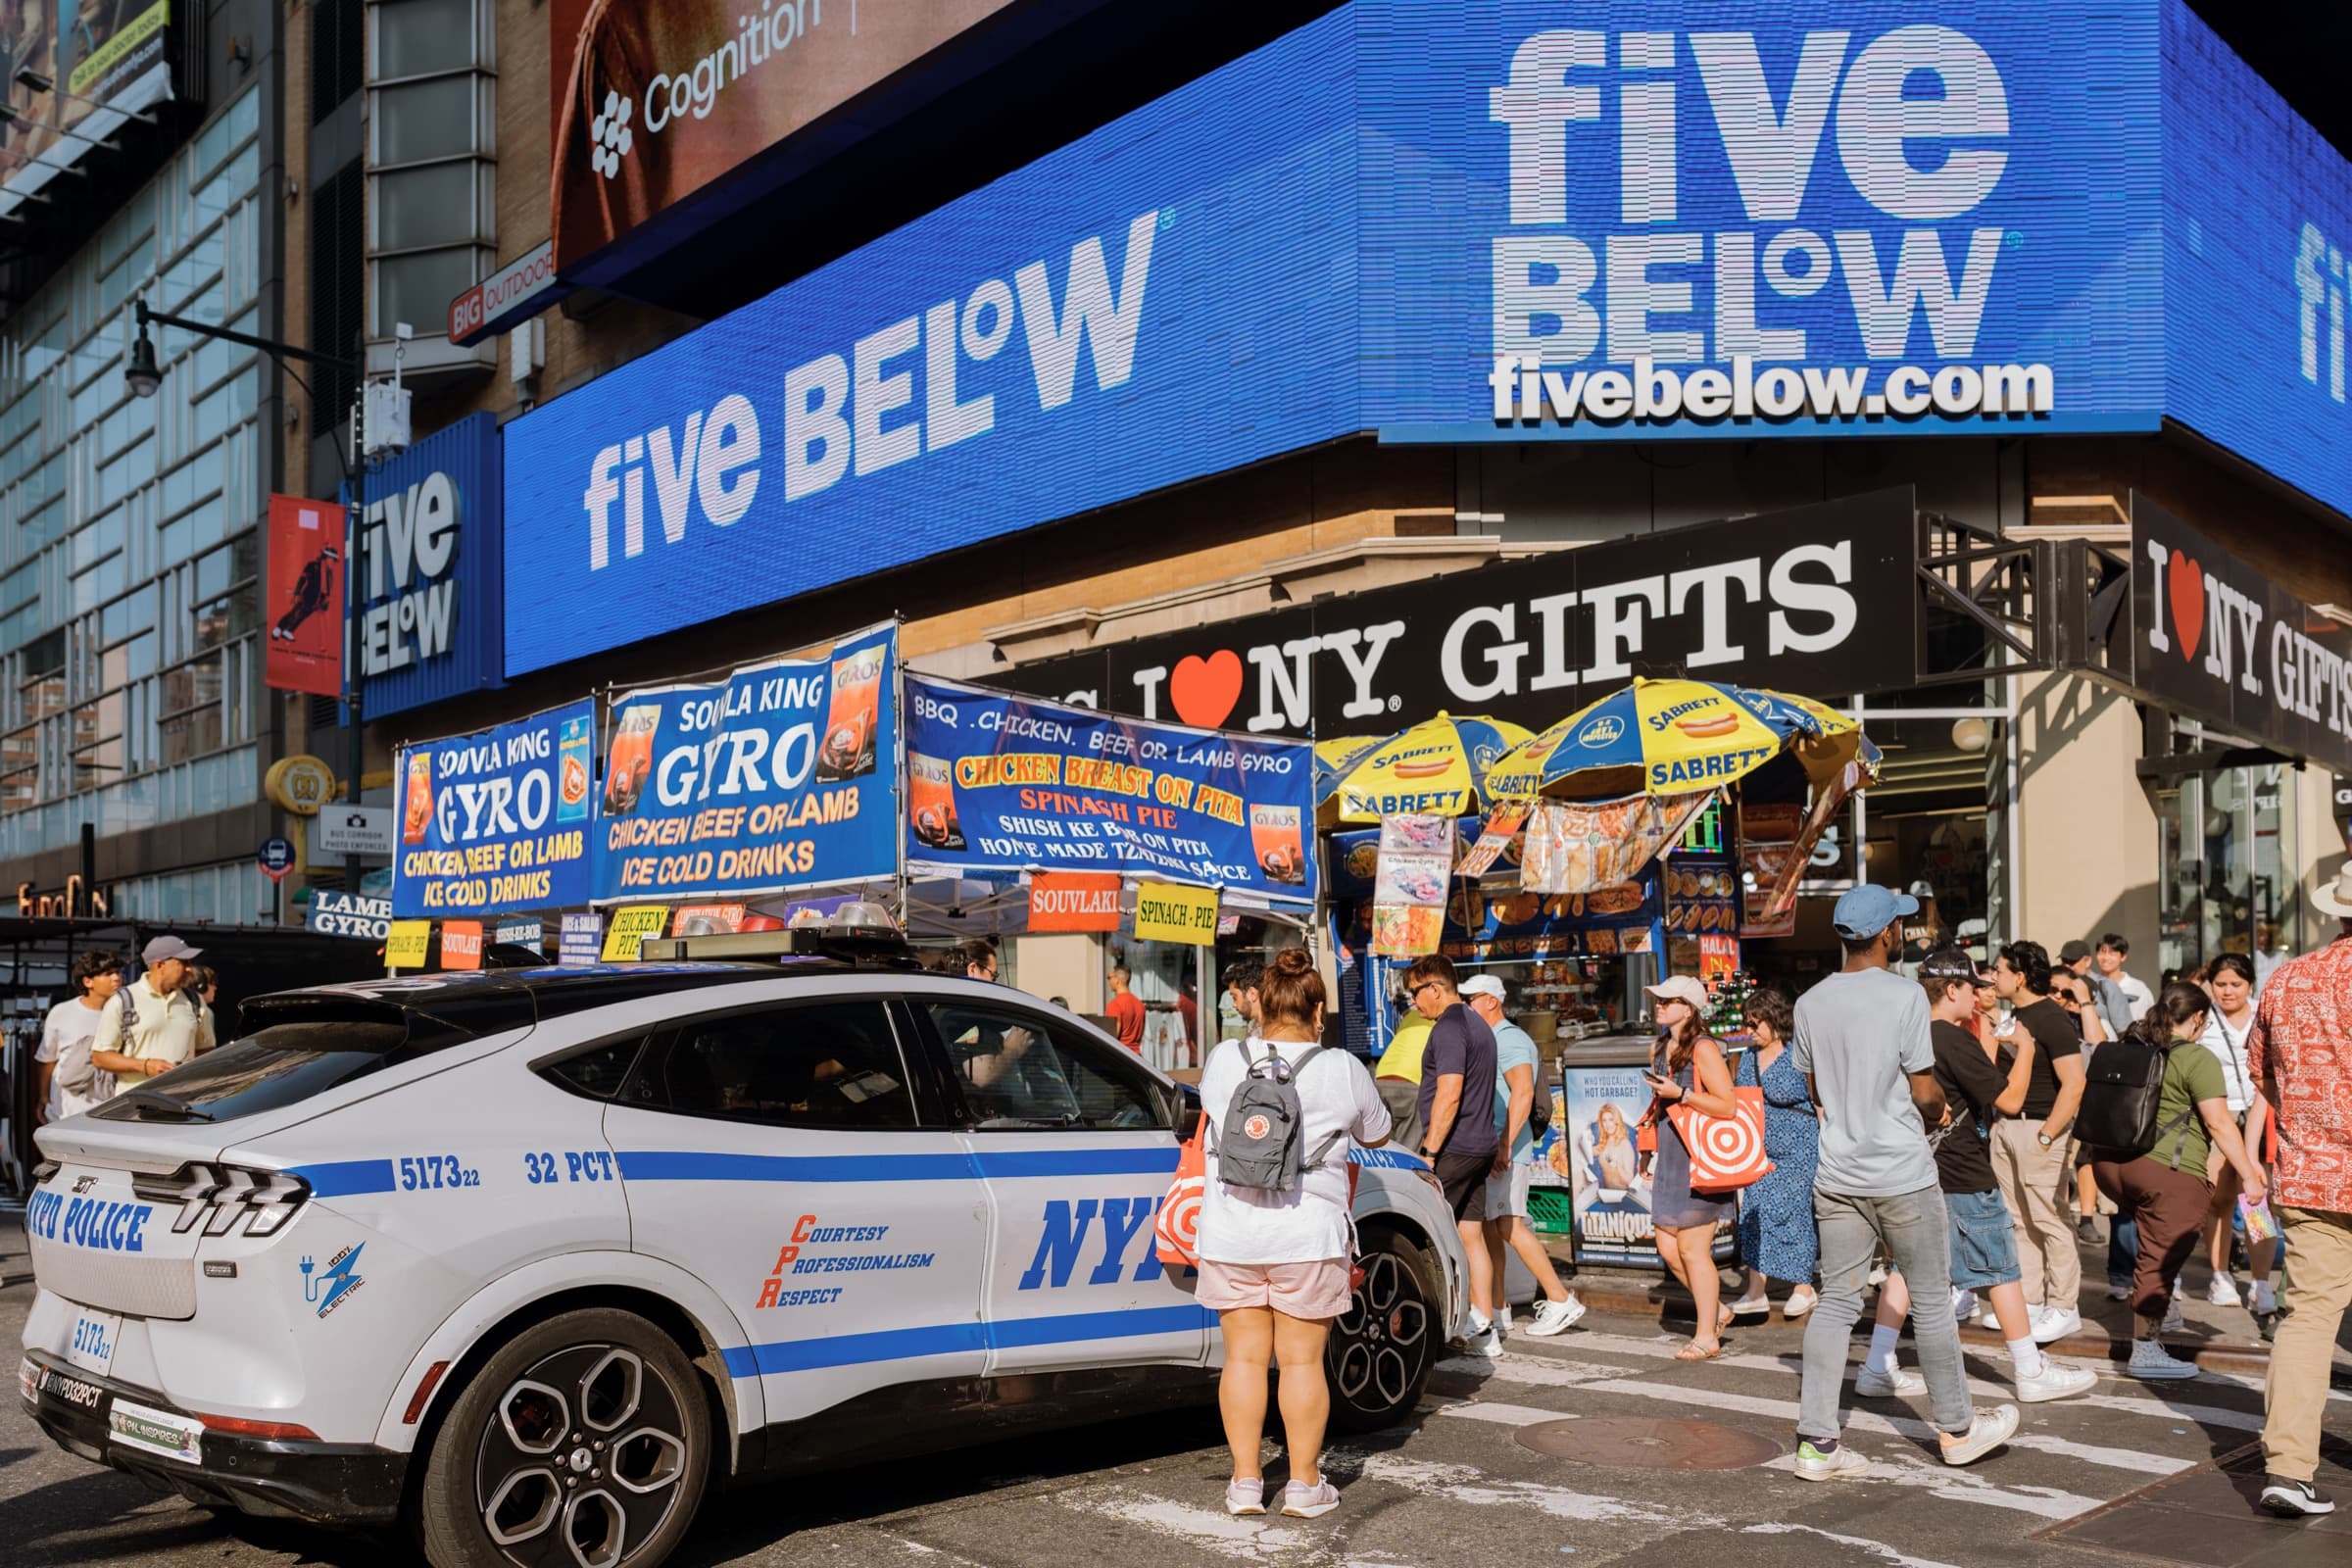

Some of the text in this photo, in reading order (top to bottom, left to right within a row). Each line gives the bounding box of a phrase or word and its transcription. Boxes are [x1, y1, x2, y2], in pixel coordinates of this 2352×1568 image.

[644, 0, 821, 133] Cognition
[1488, 24, 2010, 224] five
[454, 294, 481, 336] BIG
[2294, 221, 2352, 404] fi
[1488, 355, 2055, 422] fivebelow.com
[584, 394, 761, 570] five
[2148, 539, 2170, 653] I
[1133, 666, 1167, 720] I
[1441, 540, 1858, 702] GIFTS
[759, 674, 824, 712] KING
[914, 695, 957, 728] BBQ
[1089, 731, 1135, 757] BEEF
[1141, 740, 1168, 761] OR
[1176, 746, 1235, 769] LAMB
[1241, 753, 1292, 774] GYRO
[1648, 697, 1721, 733] SABRETT
[507, 728, 551, 767] KING
[657, 722, 816, 808] GYRO
[1372, 745, 1455, 770] SABRETT
[1651, 747, 1771, 787] SABRETT
[437, 768, 551, 844] GYRO
[956, 753, 1246, 826] CHICKEN BREAST ON PITA
[608, 786, 859, 852] CHICKEN BEEF OR LAMB
[999, 815, 1064, 838] SHISH
[1067, 821, 1100, 838] KE
[1143, 833, 1170, 853] ON
[1171, 837, 1214, 858] PITA
[1137, 806, 1178, 830] PIE
[466, 843, 506, 874] BEEF
[510, 840, 533, 868] OR
[536, 830, 584, 864] LAMB
[620, 840, 815, 887] ICE COLD DRINKS
[979, 837, 1043, 858] HOME
[1045, 843, 1108, 860] MADE
[316, 892, 392, 919] LAMB
[423, 870, 551, 906] ICE COLD DRINKS
[1033, 890, 1119, 913] SOUVLAKI
[612, 910, 665, 933] CHICKEN
[1140, 900, 1214, 929] SPINACH PIE
[443, 933, 482, 956] SOUVLAKI
[1701, 935, 1736, 956] HALAL
[1585, 1087, 1639, 1098] HOT GARBAGE?
[524, 1152, 559, 1184] 32
[564, 1151, 613, 1182] PCT
[1348, 1147, 1396, 1169] OLICE
[64, 1197, 154, 1252] POLICE
[790, 1214, 889, 1244] COURTESY
[1017, 1197, 1198, 1291] NY
[327, 1246, 354, 1268] 100%
[771, 1246, 936, 1276] PROFESSIONALISM
[318, 1277, 367, 1320] ELECTRIC
[755, 1278, 843, 1309] RESPECT
[46, 1372, 103, 1409] @NYPD32PCT
